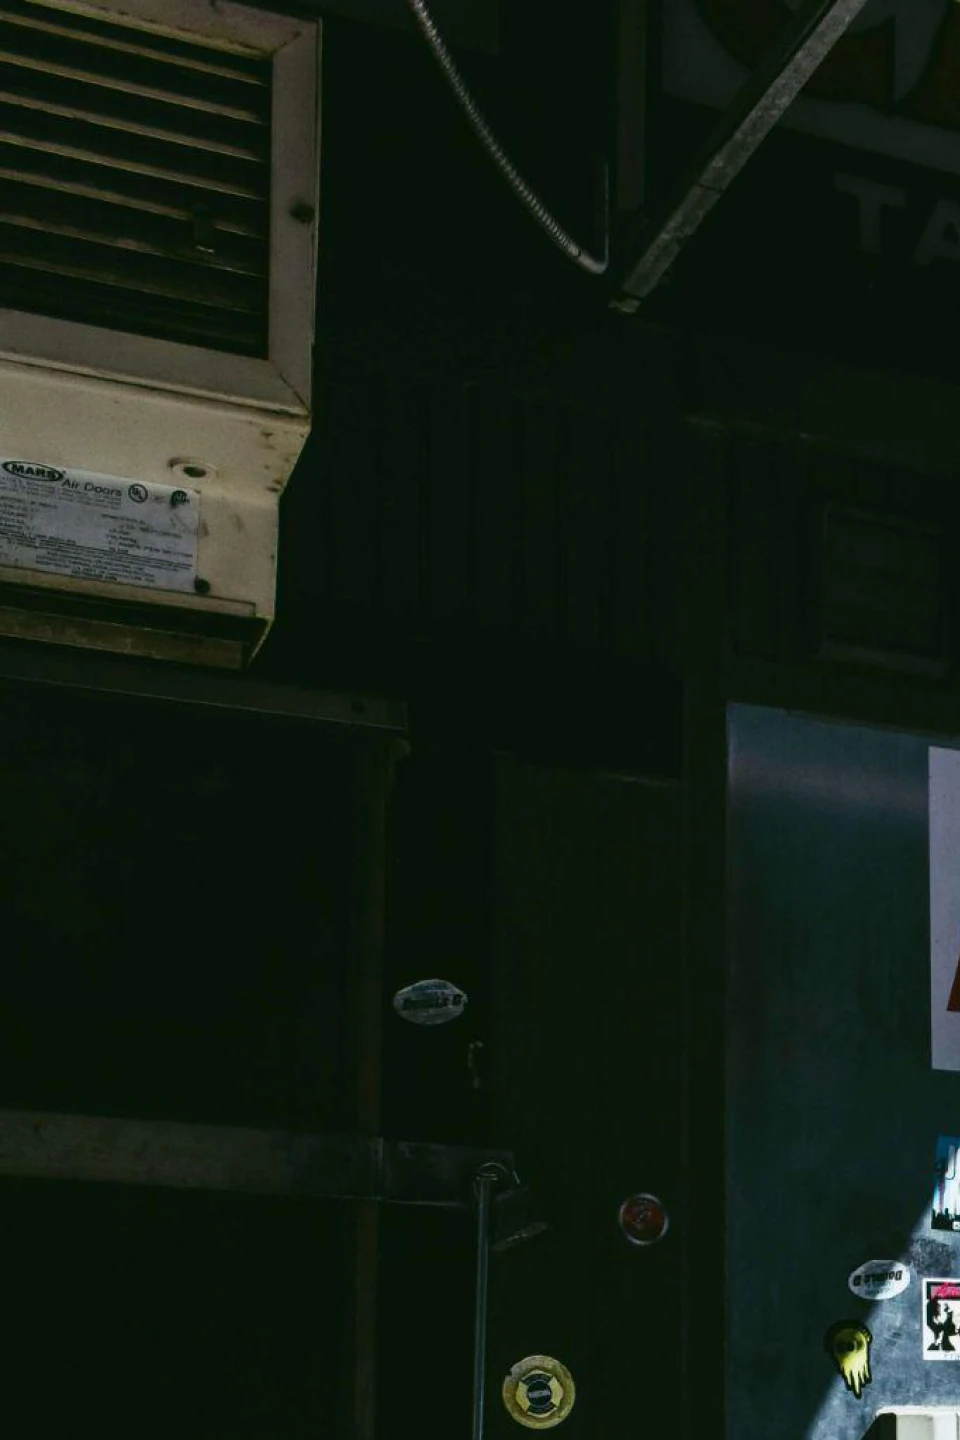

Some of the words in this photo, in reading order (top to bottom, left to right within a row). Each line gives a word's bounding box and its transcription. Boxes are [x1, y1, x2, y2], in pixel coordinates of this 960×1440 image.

[11, 463, 57, 479] MARS
[62, 478, 80, 490] Air
[83, 482, 123, 498] Doors
